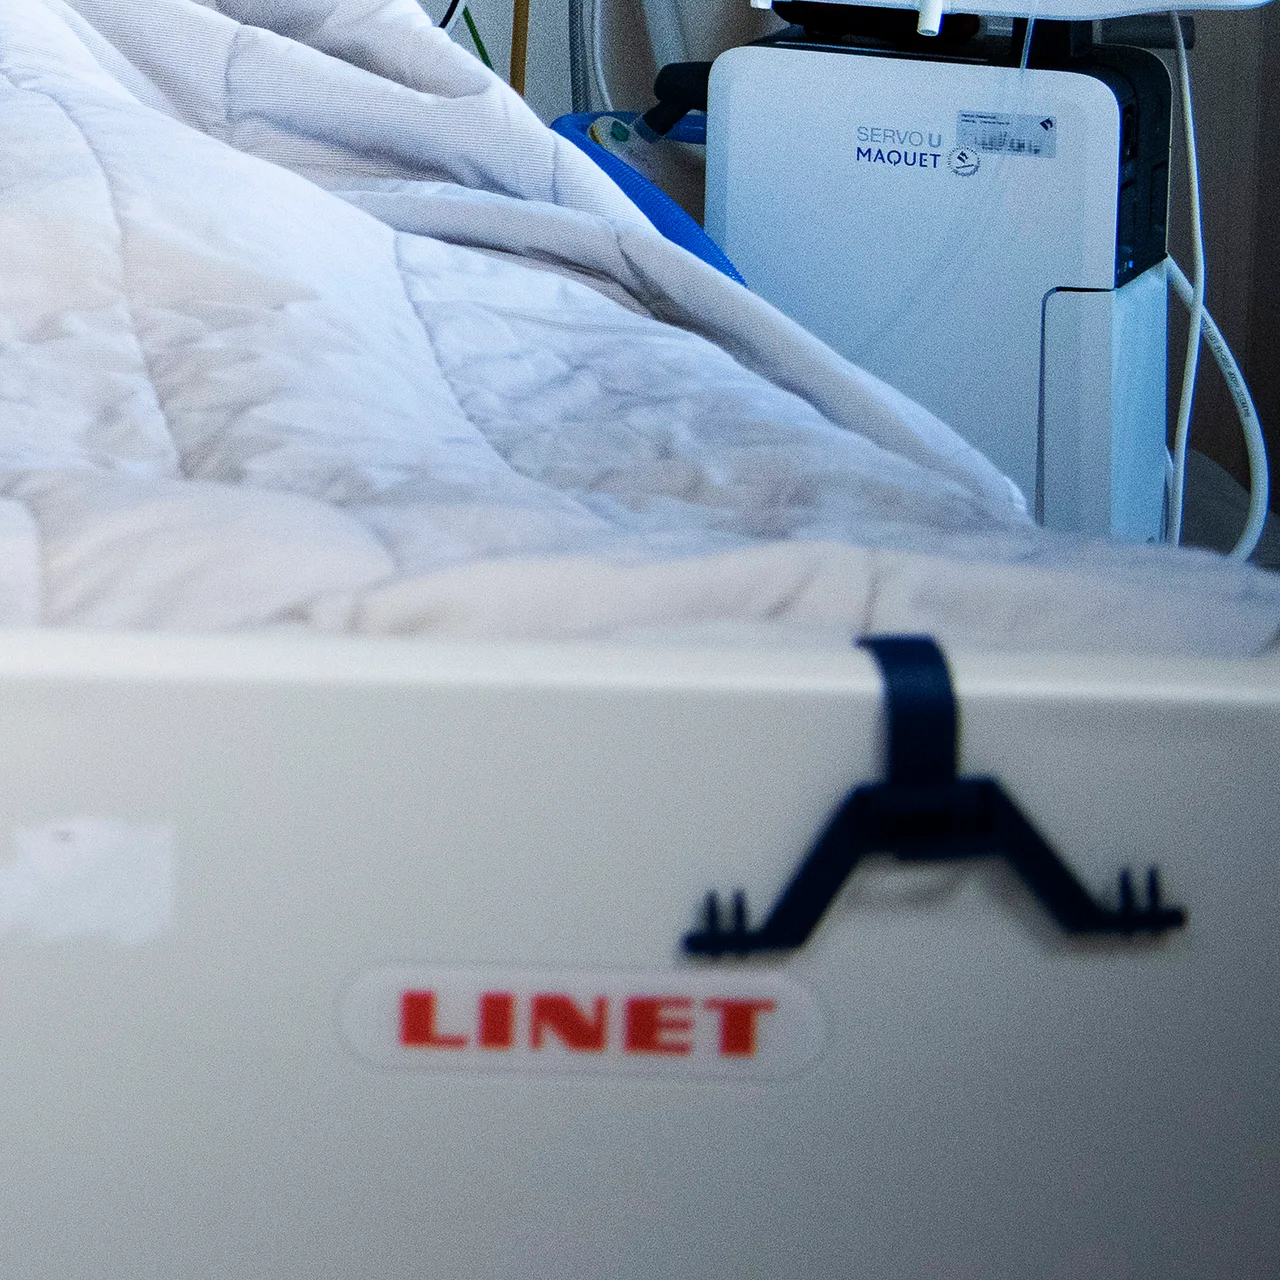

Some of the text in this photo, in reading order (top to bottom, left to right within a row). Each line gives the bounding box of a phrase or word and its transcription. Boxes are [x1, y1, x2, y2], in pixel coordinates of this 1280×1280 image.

[856, 126, 942, 148] SERVO U
[856, 146, 942, 168] MAQUET
[398, 988, 777, 1058] LINET
